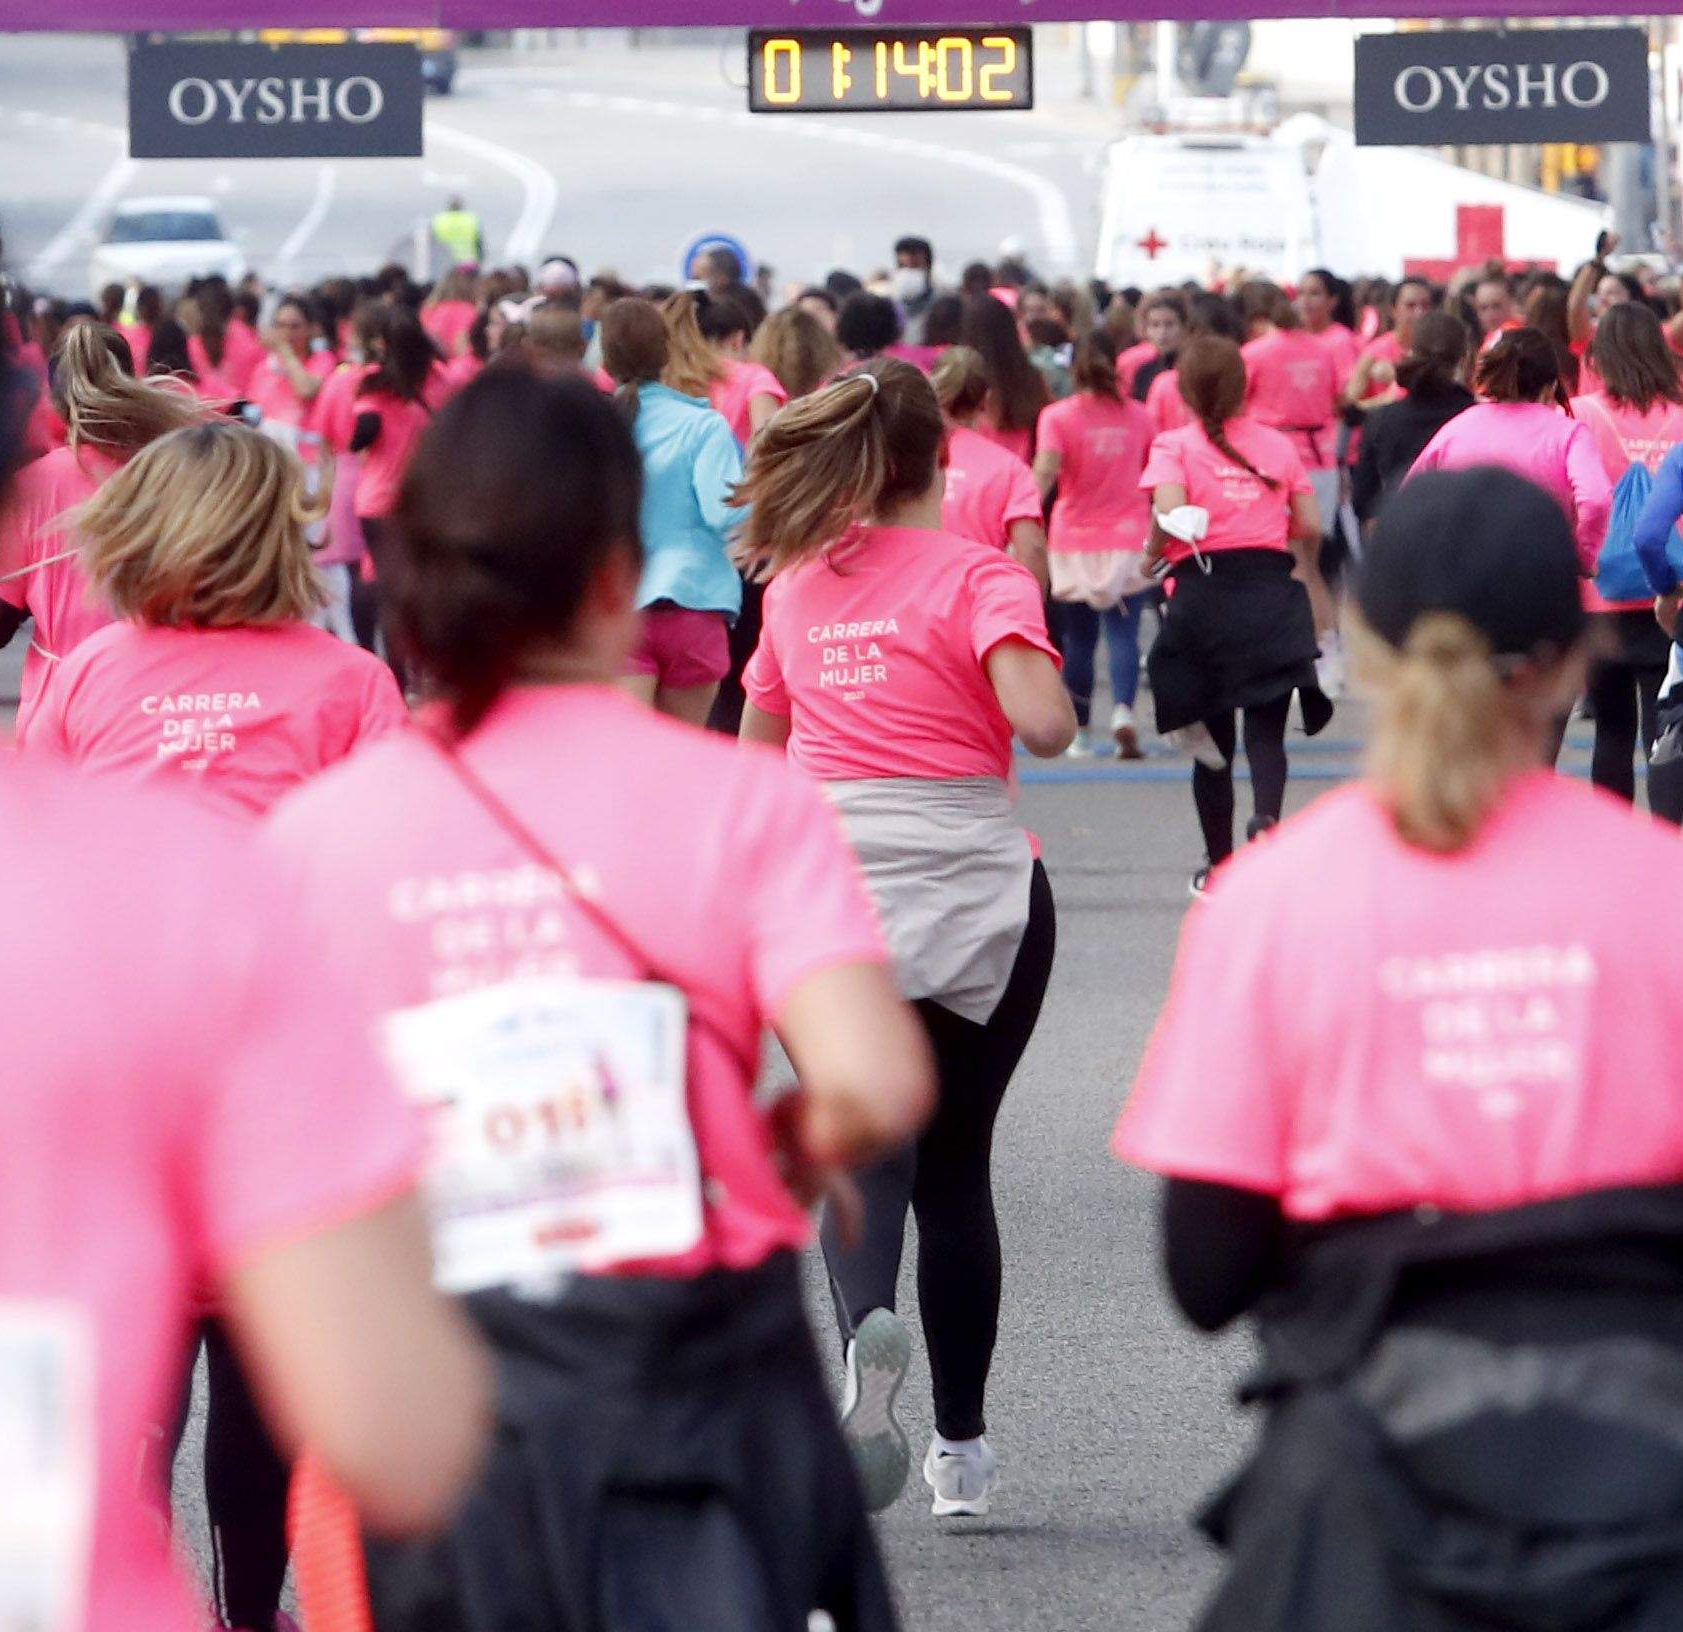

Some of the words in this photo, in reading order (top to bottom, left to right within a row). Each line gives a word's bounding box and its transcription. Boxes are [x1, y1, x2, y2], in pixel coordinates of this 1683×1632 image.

[1394, 60, 1610, 112] OYSHO
[168, 75, 385, 127] OYSHO
[807, 618, 900, 644] CARRERA
[822, 645, 849, 665] DE
[855, 641, 882, 660] LA
[820, 664, 888, 688] MUJER
[140, 691, 262, 715] CARRERA
[163, 718, 196, 738] DE
[202, 713, 234, 731] LA
[156, 732, 237, 761] MUJER
